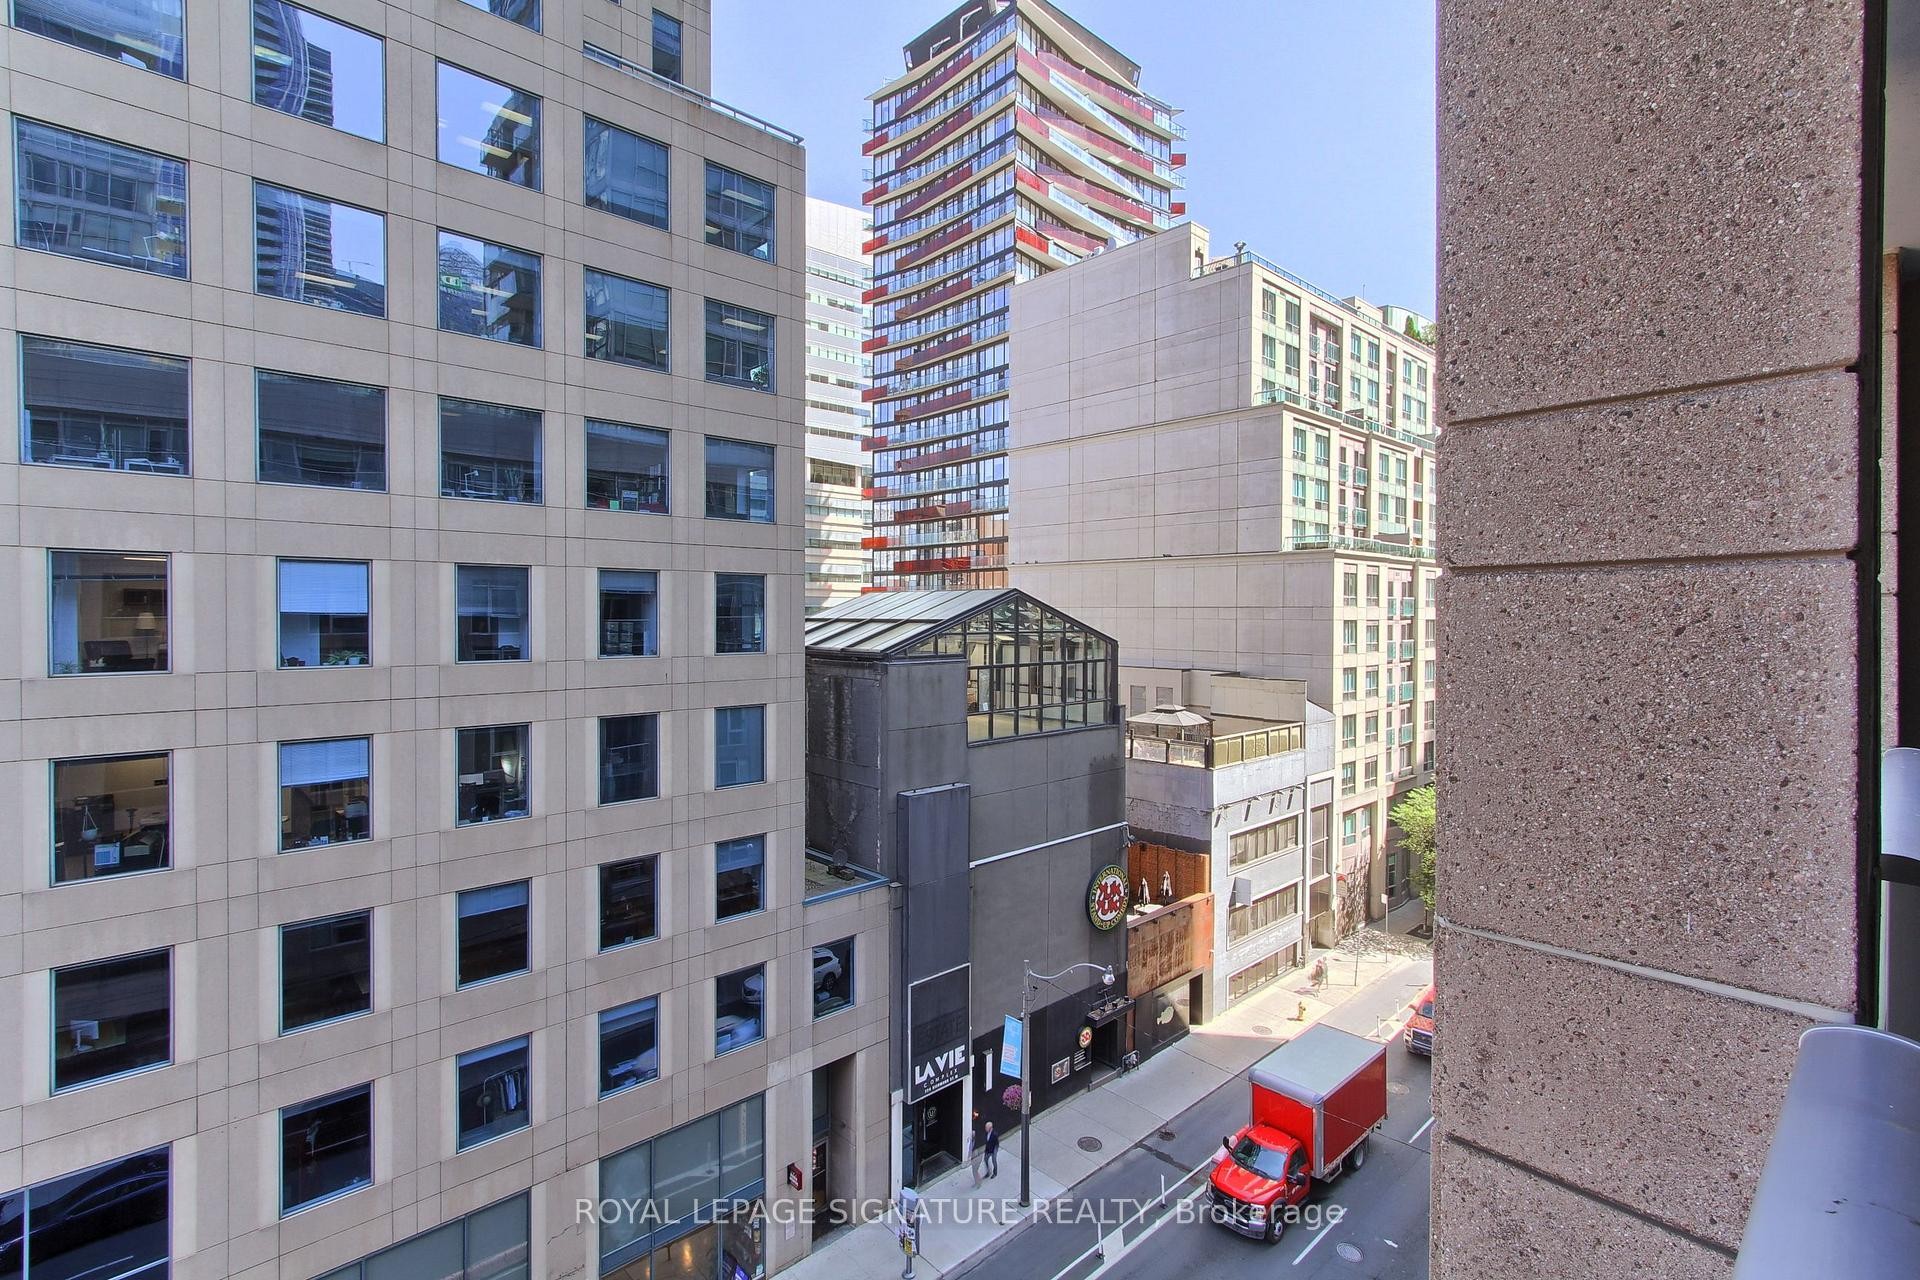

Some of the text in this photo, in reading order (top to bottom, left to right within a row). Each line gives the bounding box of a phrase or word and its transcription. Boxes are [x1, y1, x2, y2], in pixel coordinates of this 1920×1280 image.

[915, 1061, 936, 1085] LA
[935, 1044, 965, 1072] VIE
[923, 1068, 958, 1089] COMPLEX
